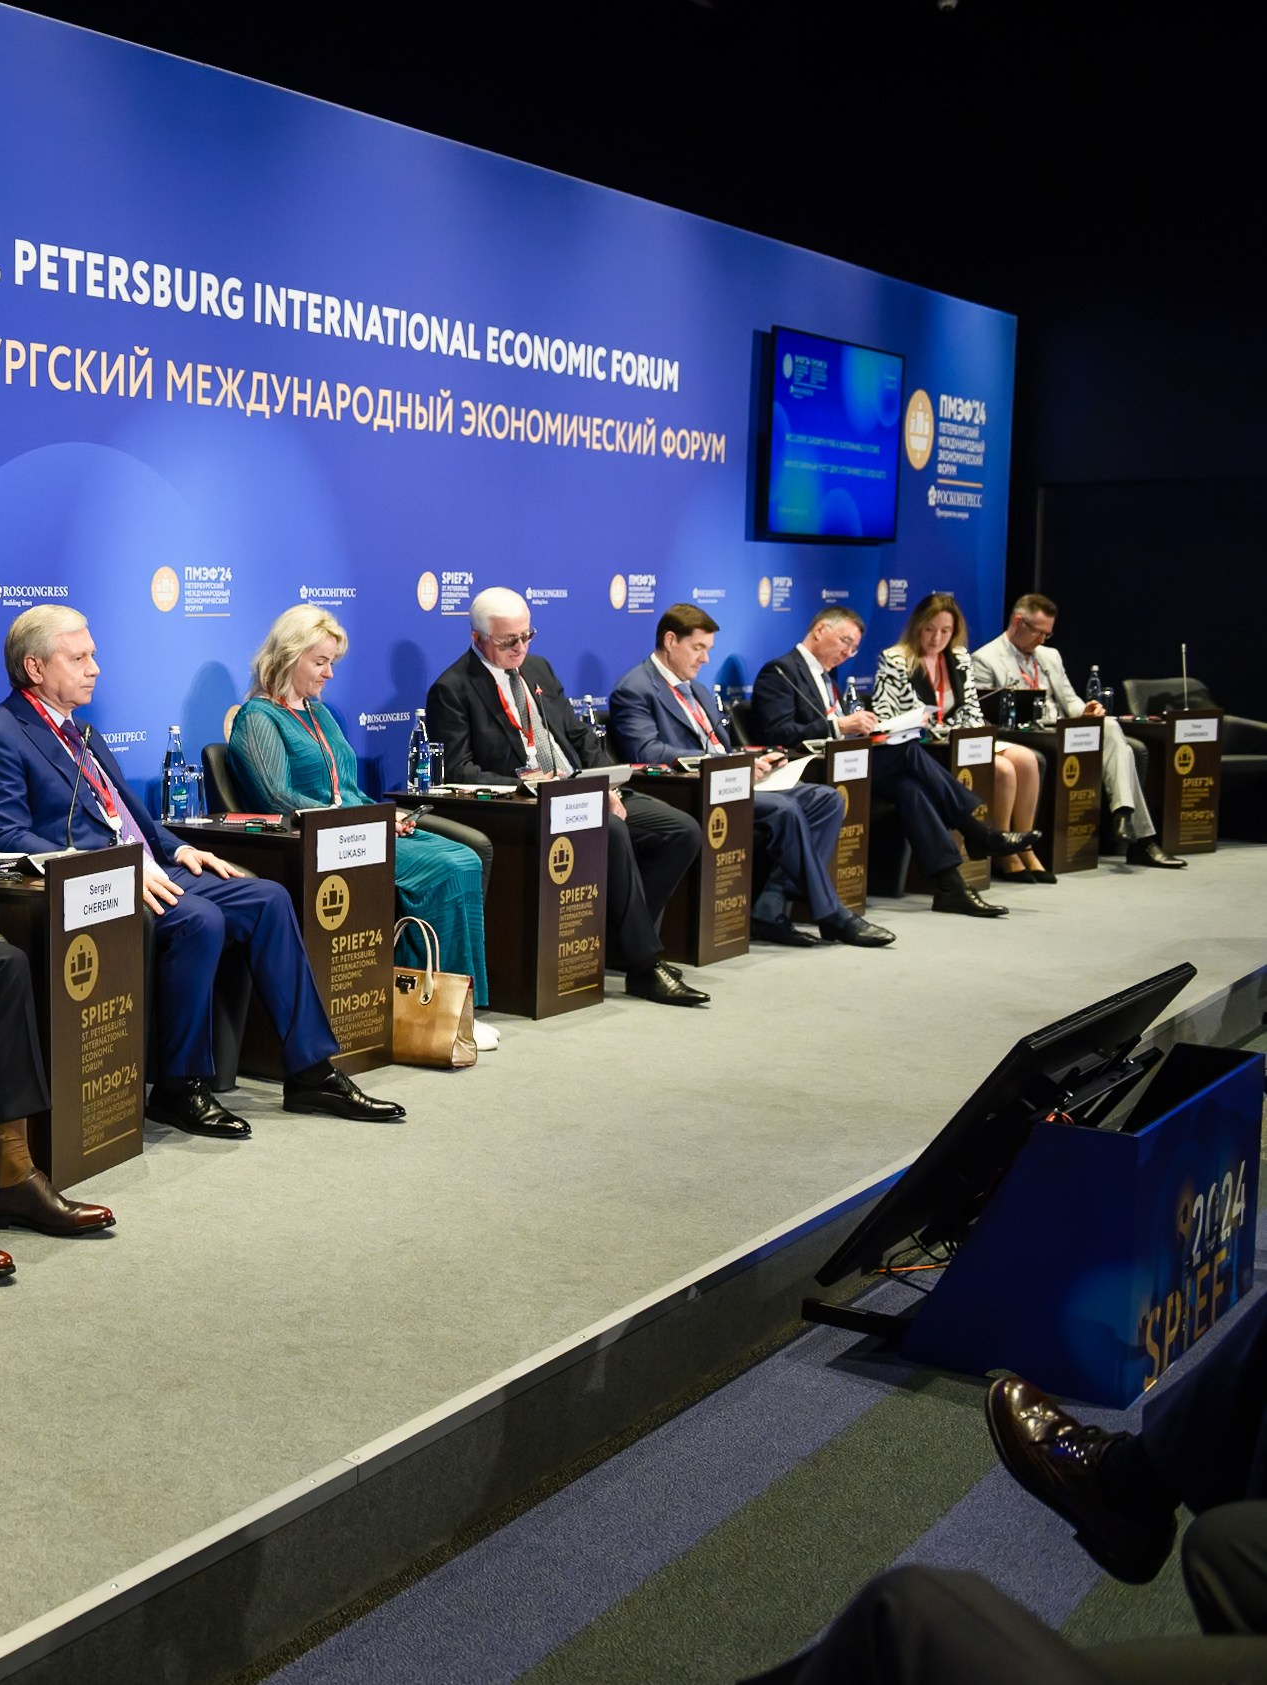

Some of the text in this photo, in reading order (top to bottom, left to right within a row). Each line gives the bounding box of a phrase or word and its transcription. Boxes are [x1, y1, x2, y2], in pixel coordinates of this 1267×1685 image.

[14, 238, 245, 320] PETERSBURG
[254, 282, 481, 361] INTERNATIONAL
[486, 326, 607, 381] ECONOMIC
[611, 349, 680, 393] FORUM
[166, 358, 454, 435] МЕЖДУНАРОДНЫЙ
[460, 399, 656, 457] ЭКОНОМИЧЕСКИЙ
[660, 424, 727, 464] ФОРУМ
[3, 585, 69, 597] ROSCONGRESS
[308, 587, 357, 598] РОСКОНГРЕСС
[184, 604, 203, 612] ФОРУМ
[367, 712, 410, 723] ROSCONGRESS
[339, 834, 366, 844] Svetlana
[339, 848, 366, 860] LUKASH
[89, 883, 111, 895] Sergey
[83, 897, 119, 916] CHEREMIN
[340, 949, 376, 961] PETERSBURG
[331, 957, 377, 974] INTERNATIONAL
[331, 969, 362, 983] ECONOMIC
[331, 981, 352, 993] FORUM
[91, 1018, 126, 1038] PETERSBURG
[82, 1028, 128, 1052] INTERNATIONAL
[340, 1042, 352, 1051] РУМ
[82, 1043, 114, 1064] ECONOMIC
[82, 1059, 103, 1075] FORUM
[1192, 1160, 1246, 1267] 2024
